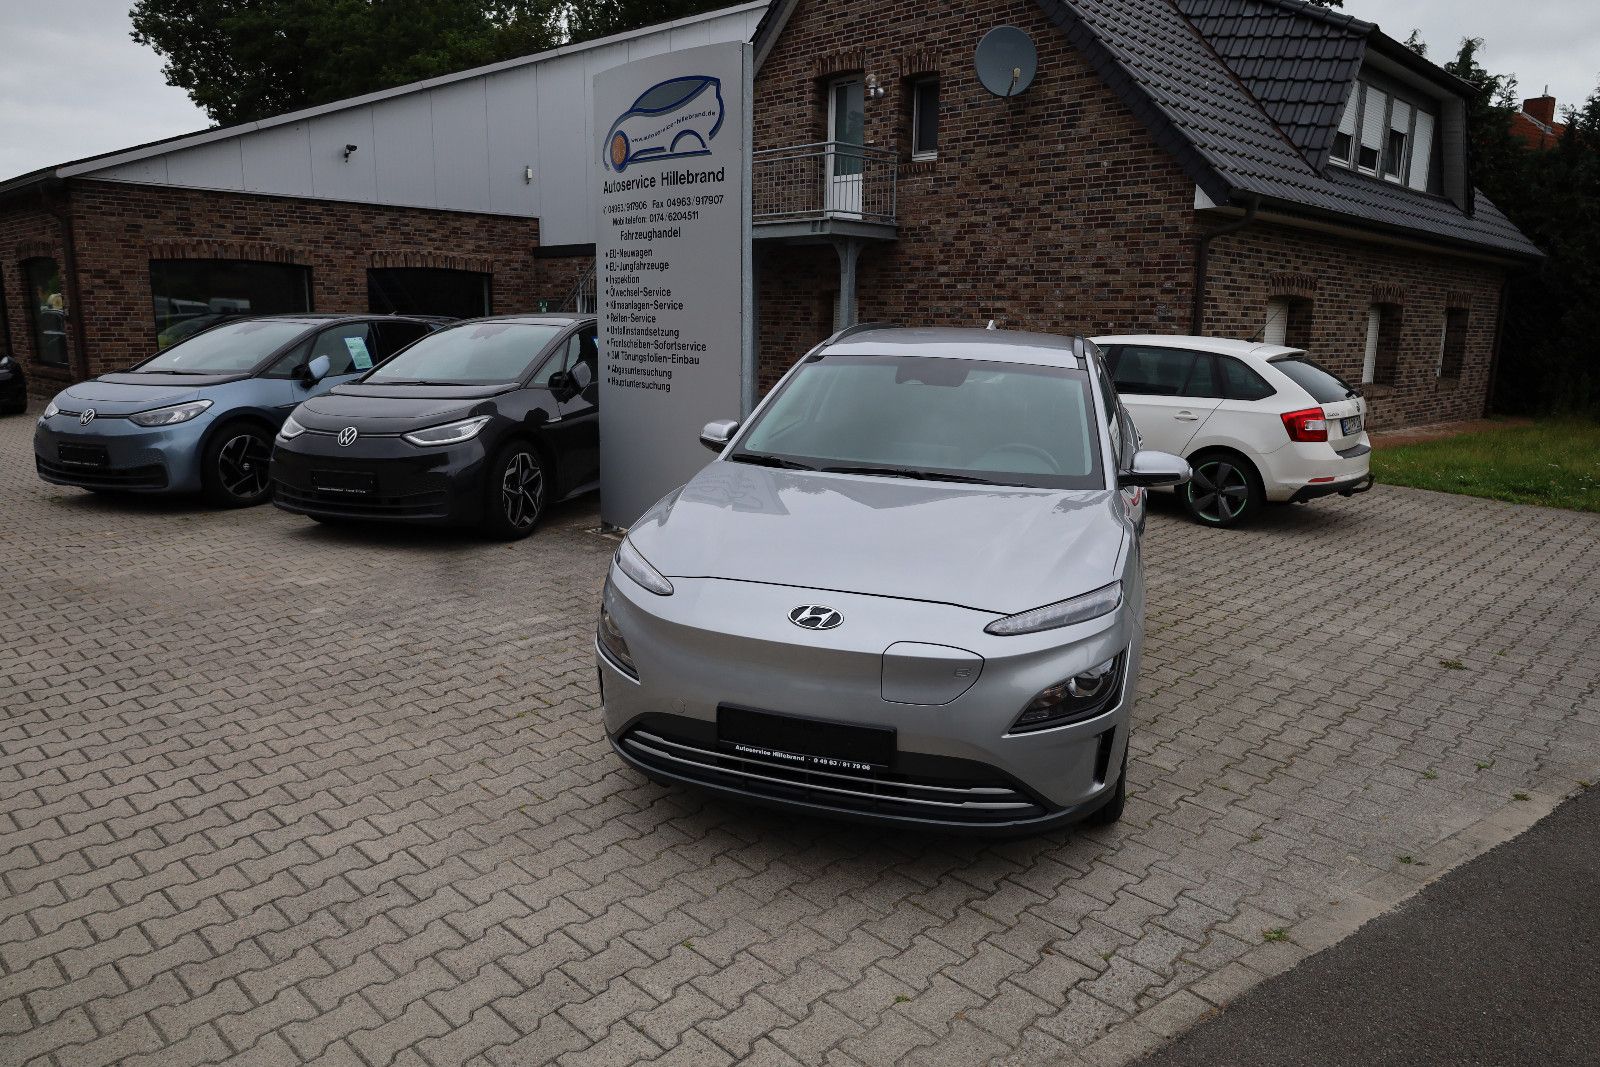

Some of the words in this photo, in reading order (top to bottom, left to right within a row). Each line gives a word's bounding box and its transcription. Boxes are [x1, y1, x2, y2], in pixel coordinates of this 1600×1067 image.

[603, 174, 656, 195] Autoservice
[661, 167, 725, 187] Hillebrand
[652, 199, 664, 209] Fax
[666, 194, 724, 208] 04963/917907
[649, 210, 699, 223] 0174/6204511
[620, 227, 681, 241] Fahrzeughandel
[609, 248, 653, 259] EU-Neuwagen
[609, 261, 670, 273] EU-Jungfahrzeuge
[609, 275, 640, 285] Inspektion
[610, 285, 671, 297] Ölwechsel-Service
[610, 300, 684, 311] Klimaanlagen-Service
[610, 312, 656, 323] Reifen-Service
[610, 325, 680, 339] Unfallinstandsetzung
[610, 338, 707, 352] Frontscheiben-Sofortservice
[621, 351, 700, 365] Tönungsfolien-Einbau
[611, 364, 672, 379] Abgasuntersuchung
[611, 377, 671, 393] Hauptuntersuchung
[735, 744, 771, 756] Autoservice
[772, 751, 805, 762] Hillebrand
